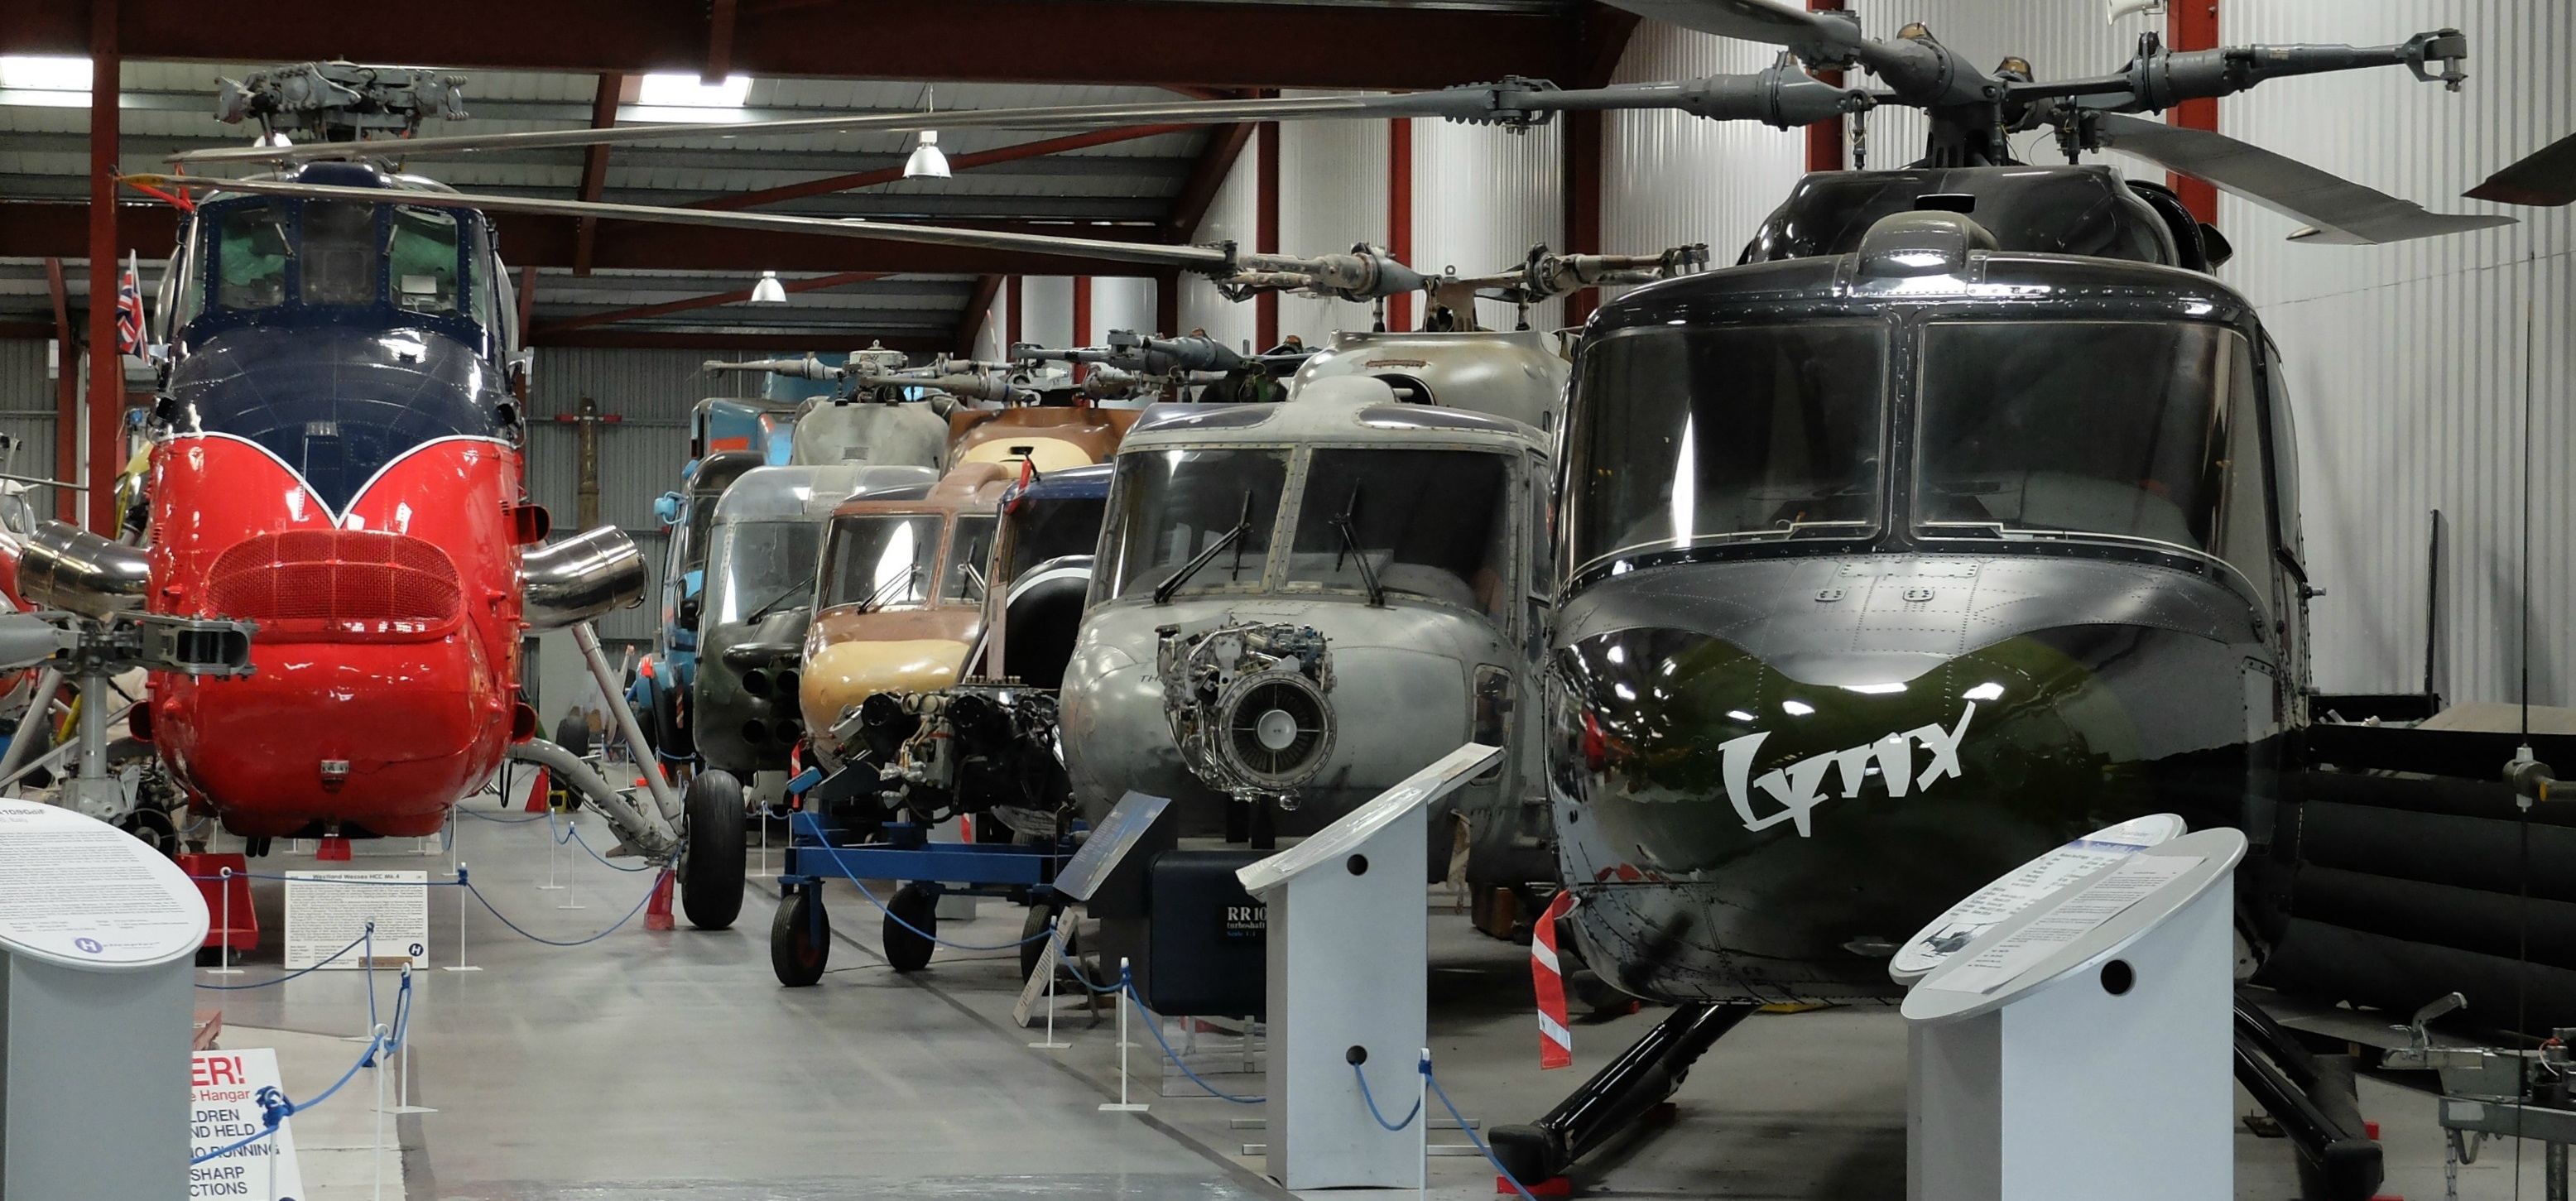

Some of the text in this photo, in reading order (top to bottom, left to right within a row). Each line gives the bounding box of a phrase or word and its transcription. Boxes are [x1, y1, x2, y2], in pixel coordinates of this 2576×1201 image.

[1718, 700, 1977, 838] Lynx
[199, 1089, 251, 1103] Hangar
[214, 1123, 256, 1137] HELD
[190, 1166, 245, 1181] SHARP
